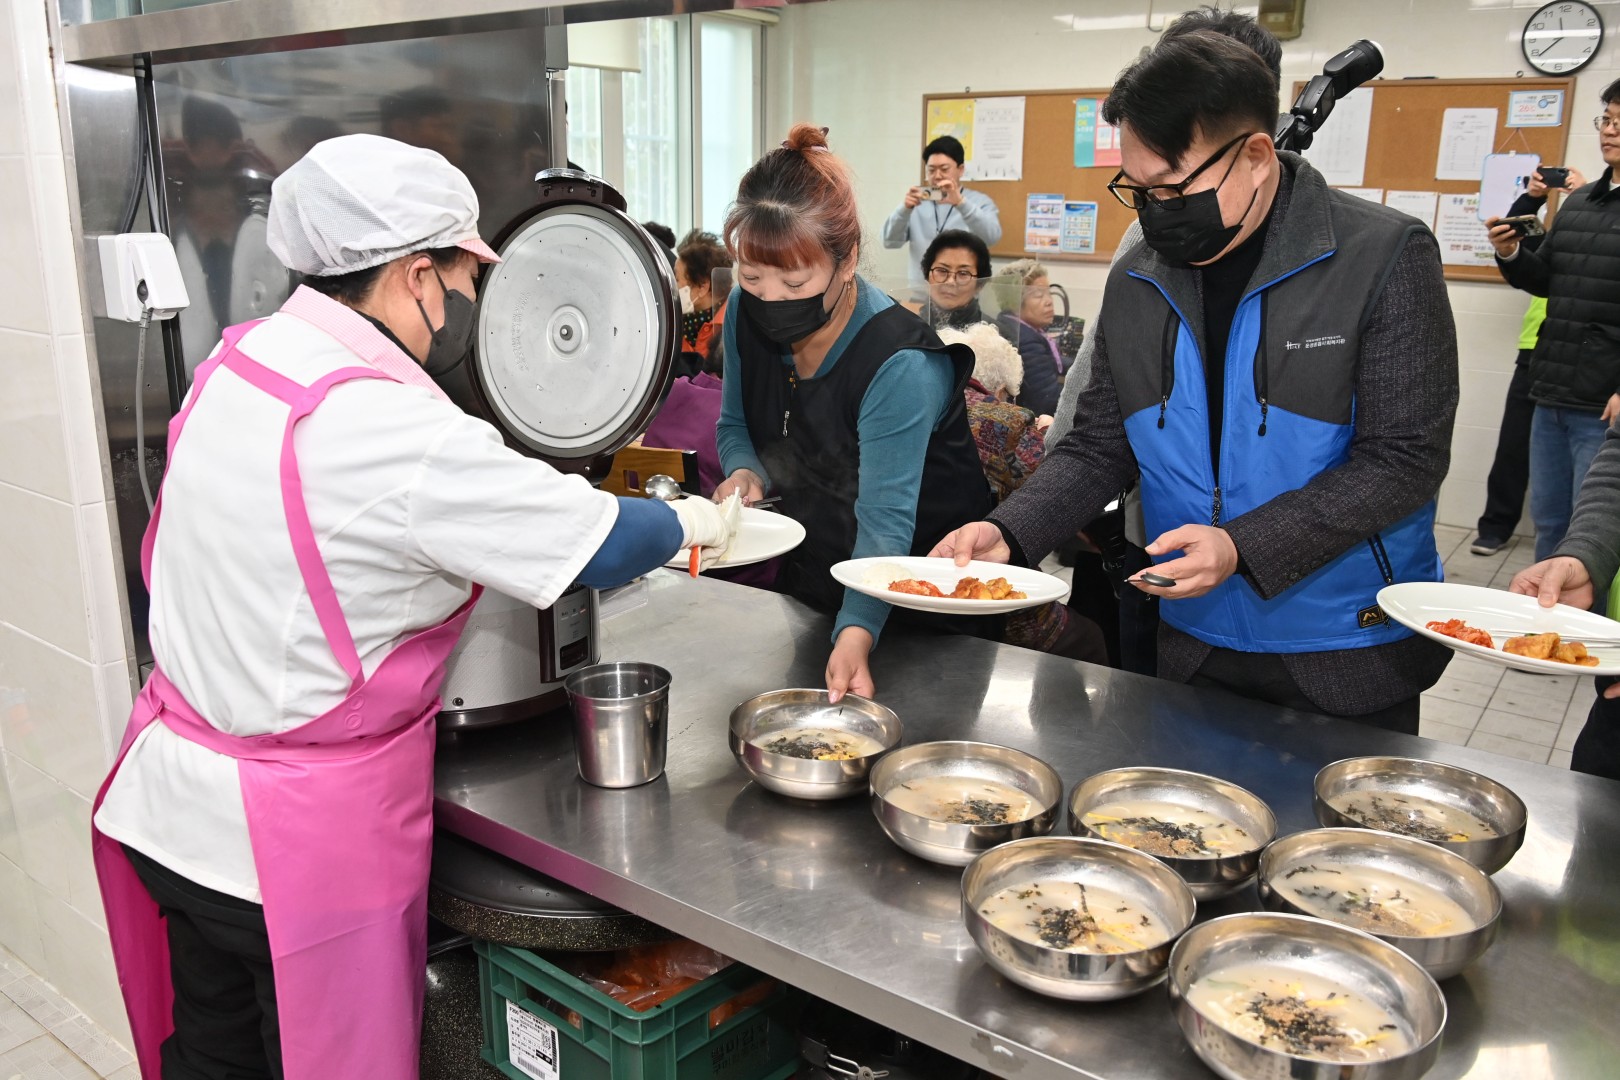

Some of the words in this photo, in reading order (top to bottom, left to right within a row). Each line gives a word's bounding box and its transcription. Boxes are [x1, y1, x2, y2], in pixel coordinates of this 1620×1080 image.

[1559, 5, 1572, 13] 12
[1532, 22, 1545, 30] 10
[1587, 18, 1596, 26] 2
